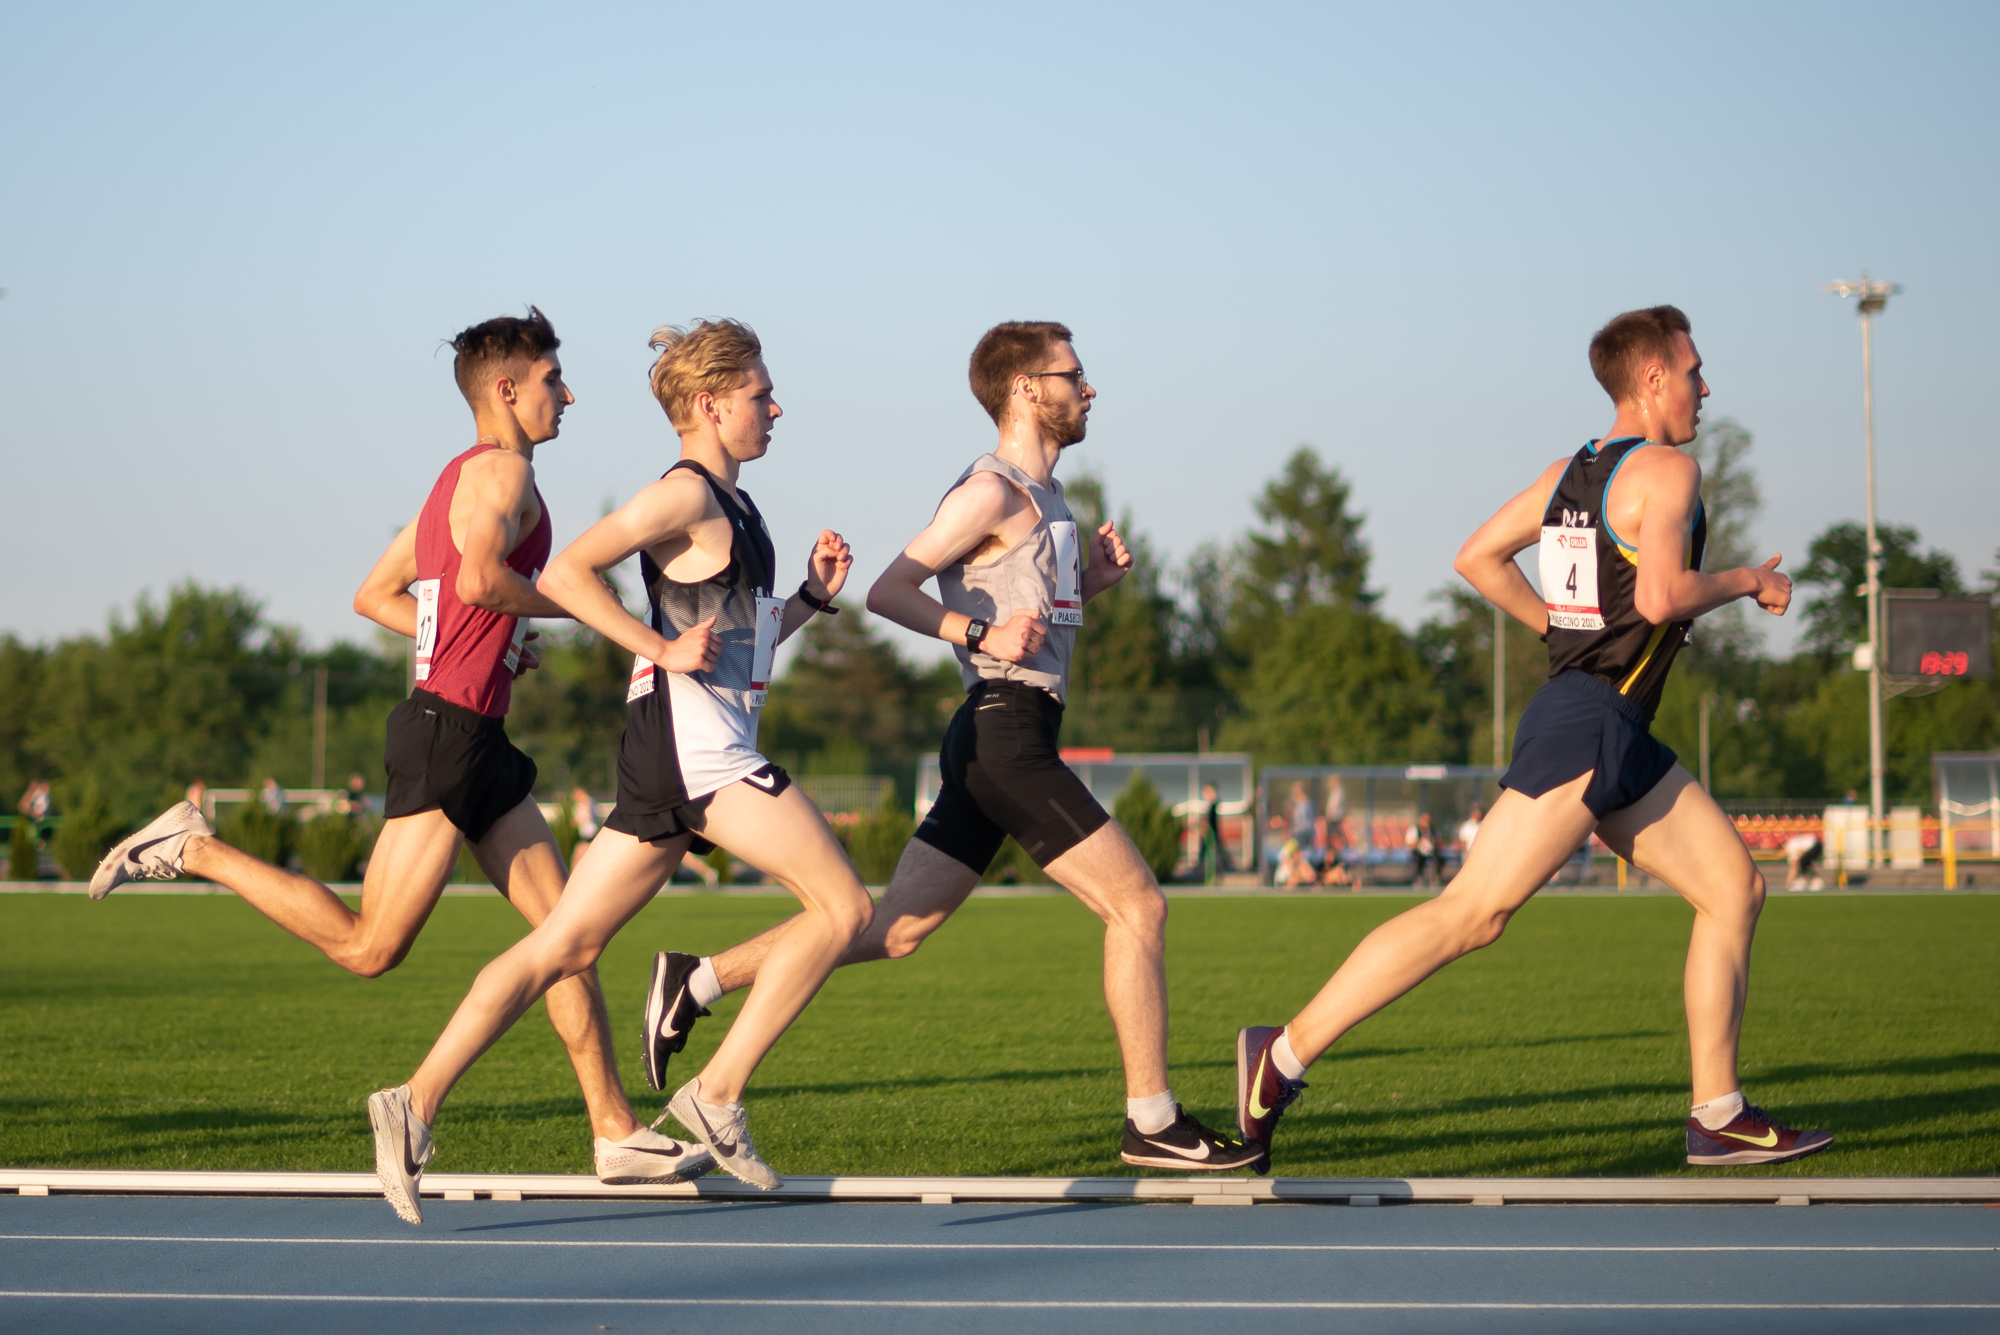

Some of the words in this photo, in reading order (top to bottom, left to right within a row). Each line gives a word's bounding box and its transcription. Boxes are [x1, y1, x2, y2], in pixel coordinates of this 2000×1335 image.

[1570, 537, 1587, 548] ORLEN
[1565, 563, 1578, 600] 4
[417, 615, 432, 651] 17
[1581, 617, 1596, 628] 2021
